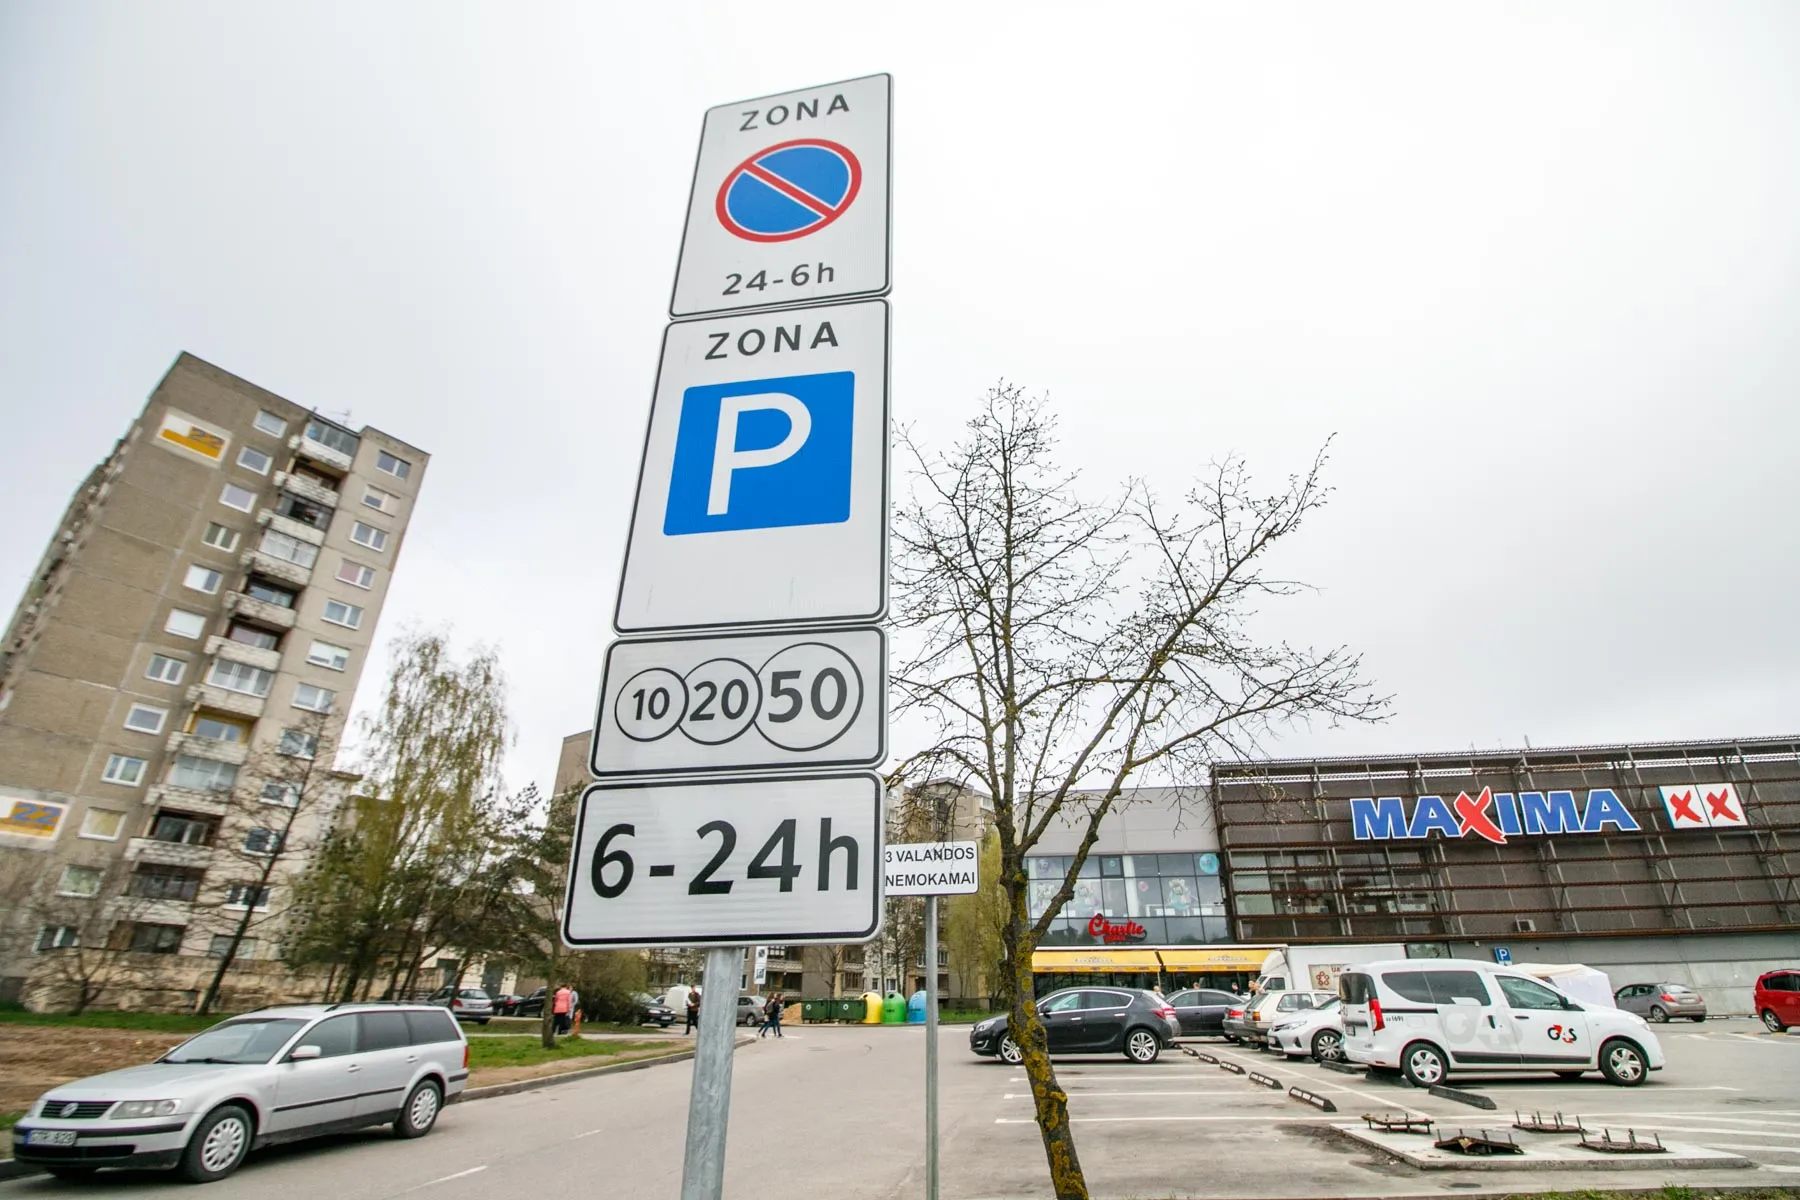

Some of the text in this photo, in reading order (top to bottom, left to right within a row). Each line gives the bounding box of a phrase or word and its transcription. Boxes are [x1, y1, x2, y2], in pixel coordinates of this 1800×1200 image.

[739, 94, 850, 131] ZONA
[722, 262, 835, 296] 24-6h
[704, 321, 839, 360] ZONA
[706, 392, 812, 516] P
[632, 667, 848, 723] 10 20 50
[1349, 785, 1642, 844] MAXIMA
[591, 817, 859, 898] 6-24h
[885, 847, 975, 863] 3 VALANDOS
[885, 872, 975, 887] NEMOKAMAI
